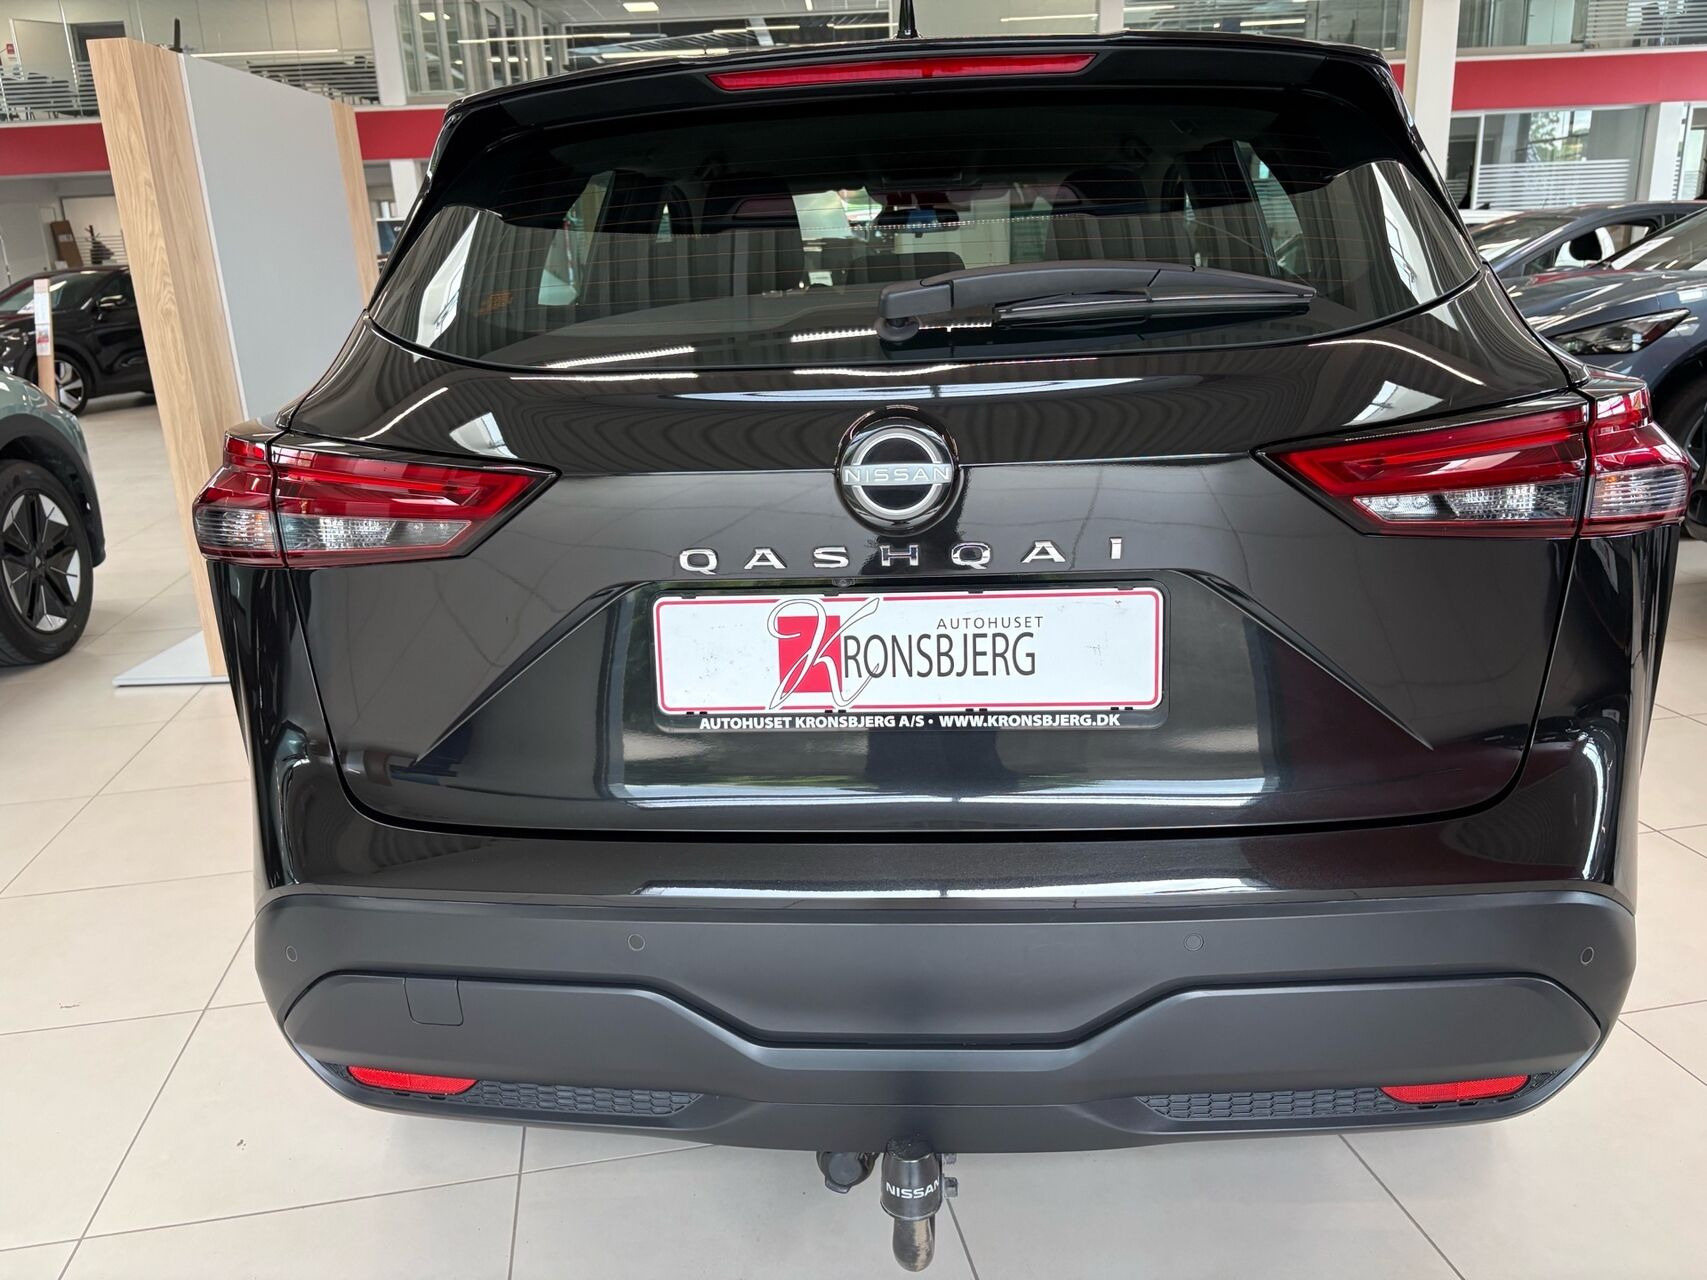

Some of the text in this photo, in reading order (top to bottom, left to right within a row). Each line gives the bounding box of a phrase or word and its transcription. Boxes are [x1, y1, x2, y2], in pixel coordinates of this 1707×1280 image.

[844, 466, 950, 483] NISSAN
[679, 537, 1124, 575] QASHQAI
[936, 616, 1044, 631] AUTOHUSET
[767, 597, 1036, 710] KRONSBJERG
[700, 713, 1121, 731] AUTOHUSET KRONSBJERG A/S WWW.KRONSBJERG.DK
[886, 1178, 940, 1198] NISSAN
